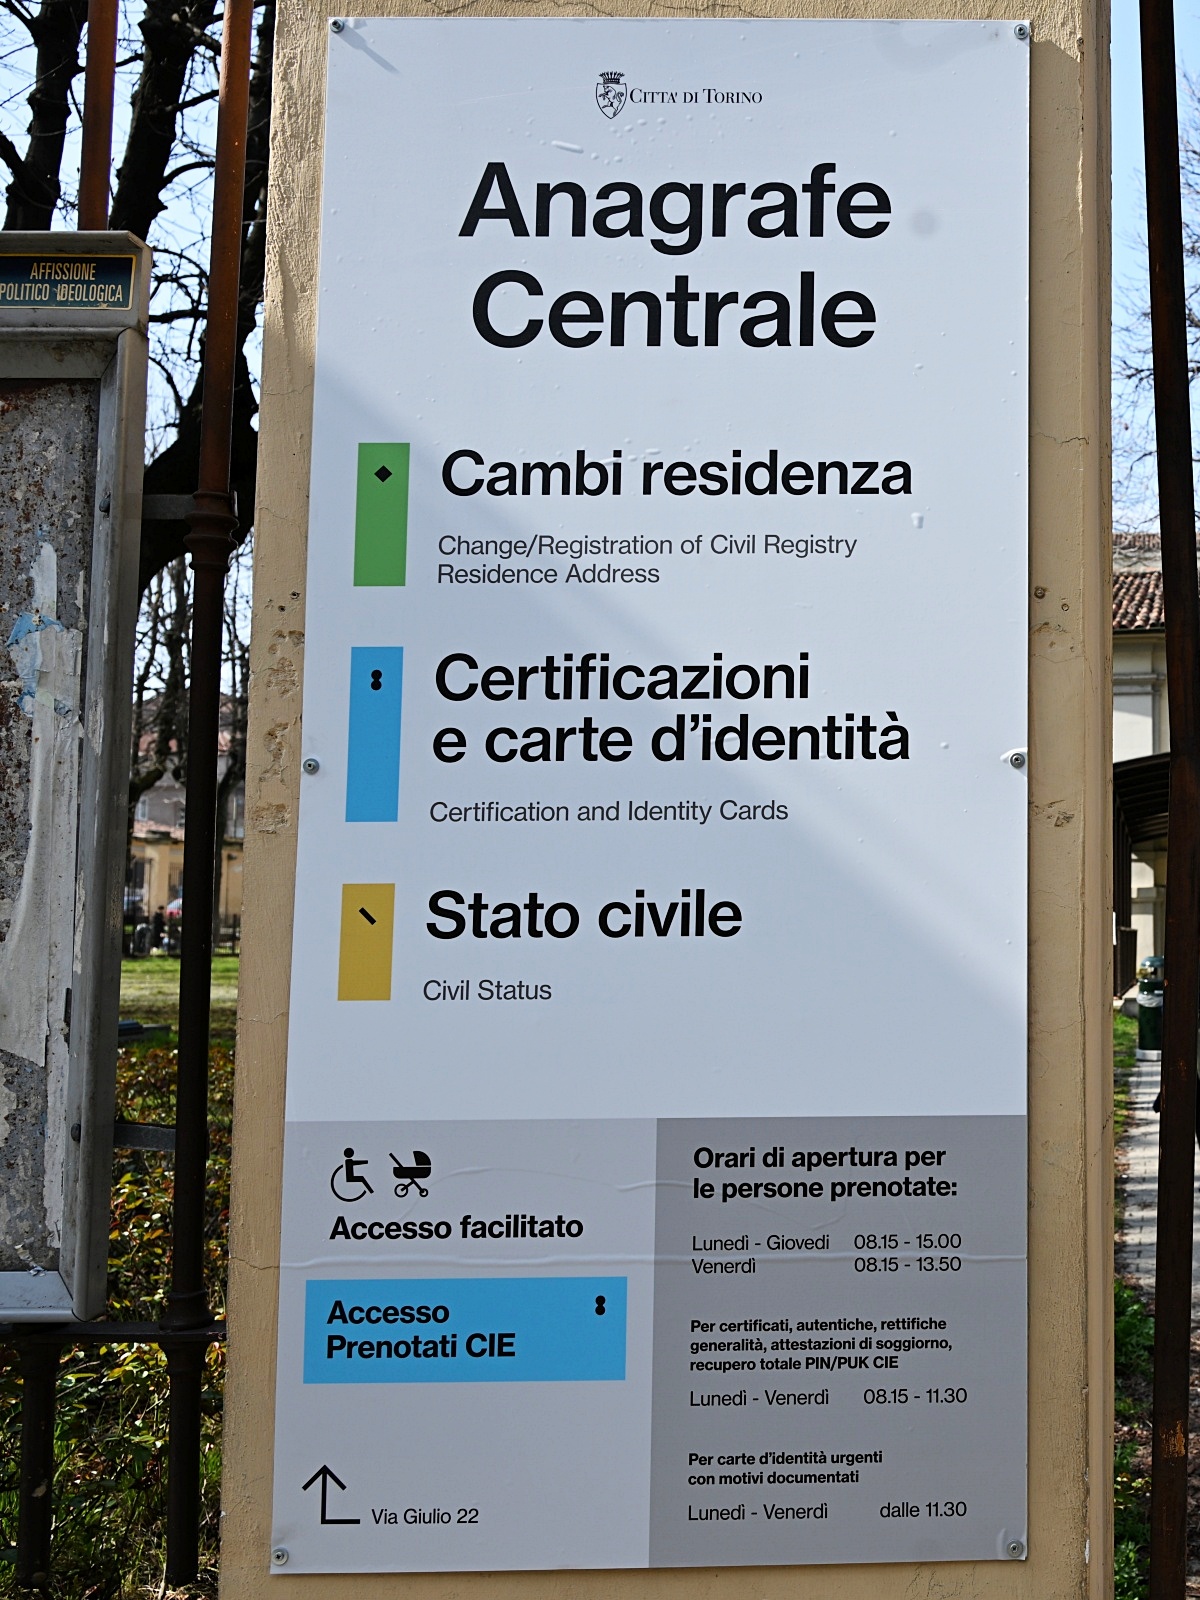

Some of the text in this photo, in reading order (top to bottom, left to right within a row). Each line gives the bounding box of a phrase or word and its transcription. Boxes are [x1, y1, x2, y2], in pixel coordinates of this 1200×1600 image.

[683, 91, 699, 104] DI
[702, 88, 763, 104] TORINO
[457, 161, 892, 256] Anagrafe
[29, 262, 97, 281] AFFISSIONE
[0, 282, 123, 302] POLITICO IDEOLOGICA
[472, 269, 877, 349] Centrale
[441, 448, 913, 497] Cambi residenza
[438, 533, 858, 560] Change/Registration of Civil Registry
[437, 563, 660, 584] Residence Address
[435, 651, 809, 702] Certificazioni
[432, 710, 910, 764] e carte d’identità
[429, 799, 789, 826] Certification and Identity Cards
[426, 888, 743, 940] Stato civile
[423, 979, 552, 1001] Civil Status
[693, 1146, 947, 1172] Orari di apertura per
[693, 1176, 958, 1204] le persone prenotate:
[328, 1213, 584, 1241] Accesso facilitato
[692, 1234, 749, 1252] Lunedì
[853, 1233, 899, 1250] 08.15
[915, 1233, 962, 1249] 15.00
[691, 1257, 756, 1275] Venerdì
[854, 1256, 899, 1273] 08.15
[915, 1255, 962, 1272] 13.50
[326, 1299, 450, 1325] Accesso
[690, 1316, 947, 1334] Per certificati, autentiche, rettifiche
[326, 1332, 516, 1360] Prenotati CIE
[689, 1336, 953, 1355] generalità, attestazioni di soggiorno,
[689, 1355, 899, 1374] recupero totale PIN/PUK CIE
[689, 1389, 747, 1407] Lunedì
[764, 1388, 829, 1406] Venerdì
[863, 1388, 909, 1405] 08.15
[925, 1387, 968, 1404] 11.30
[688, 1450, 883, 1467] Per carte d’identità urgenti
[687, 1469, 860, 1486] con motivi documentati
[371, 1507, 479, 1525] Via Giulio 22
[688, 1503, 746, 1521] Lunedì
[762, 1502, 828, 1520] Venerdì
[879, 1501, 920, 1519] dalle
[925, 1501, 968, 1518] 11.30
